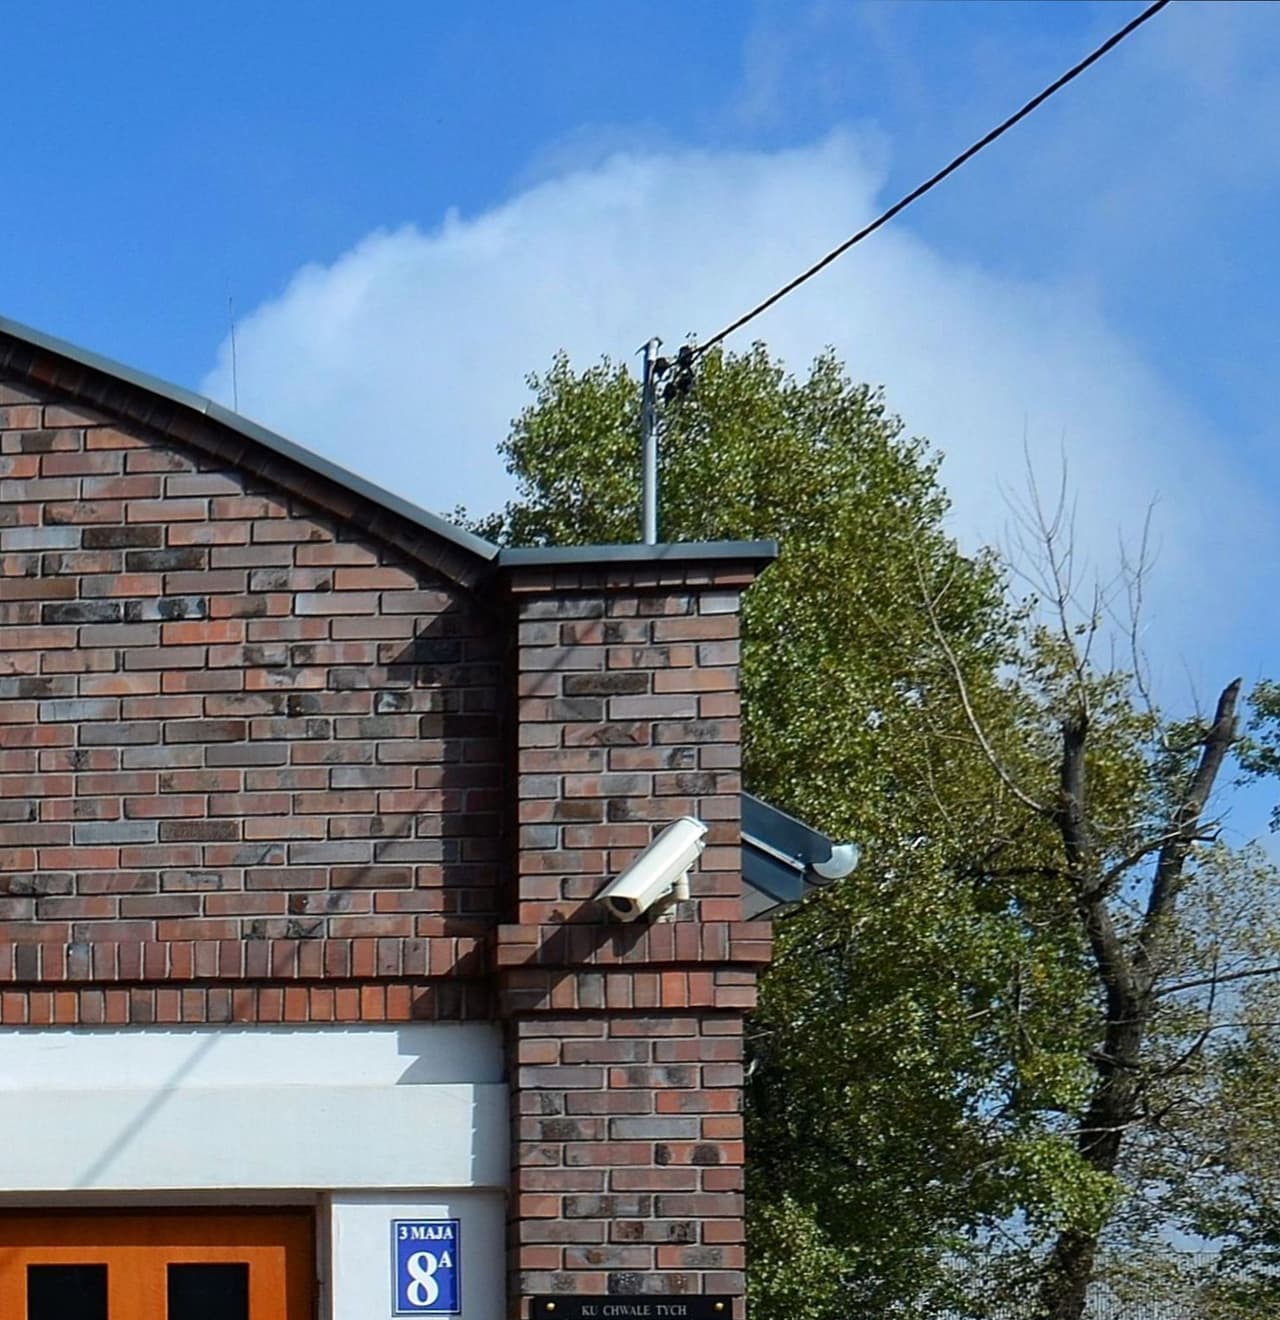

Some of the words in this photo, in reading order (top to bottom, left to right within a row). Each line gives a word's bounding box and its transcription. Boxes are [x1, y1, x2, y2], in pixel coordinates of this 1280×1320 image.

[399, 1226, 408, 1240] 3
[411, 1226, 454, 1240] MAJA
[581, 1305, 598, 1316] KU
[603, 1305, 651, 1316] CHWALE
[656, 1304, 687, 1316] TYCH
